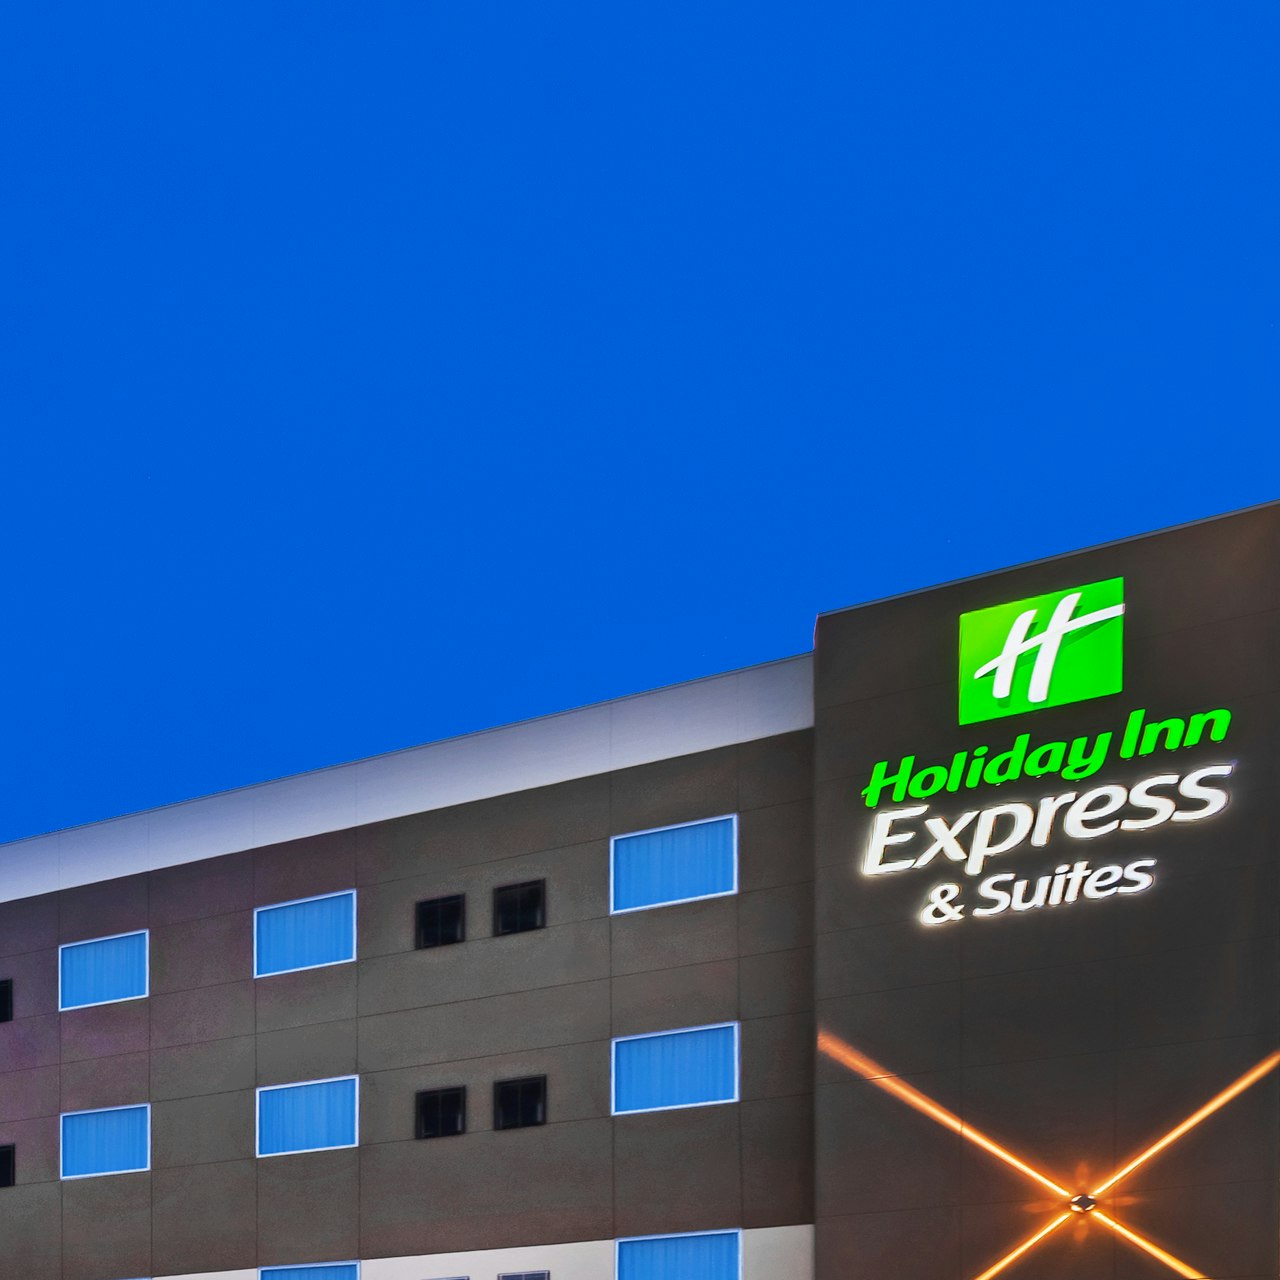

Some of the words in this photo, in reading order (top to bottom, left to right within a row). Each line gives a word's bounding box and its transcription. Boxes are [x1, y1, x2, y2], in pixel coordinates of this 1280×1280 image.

[973, 592, 1125, 703] H
[861, 733, 1112, 808] Holiday
[1120, 708, 1232, 760] Inn
[861, 763, 1233, 876] Express
[919, 882, 965, 926] &
[972, 859, 1157, 918] Suites
